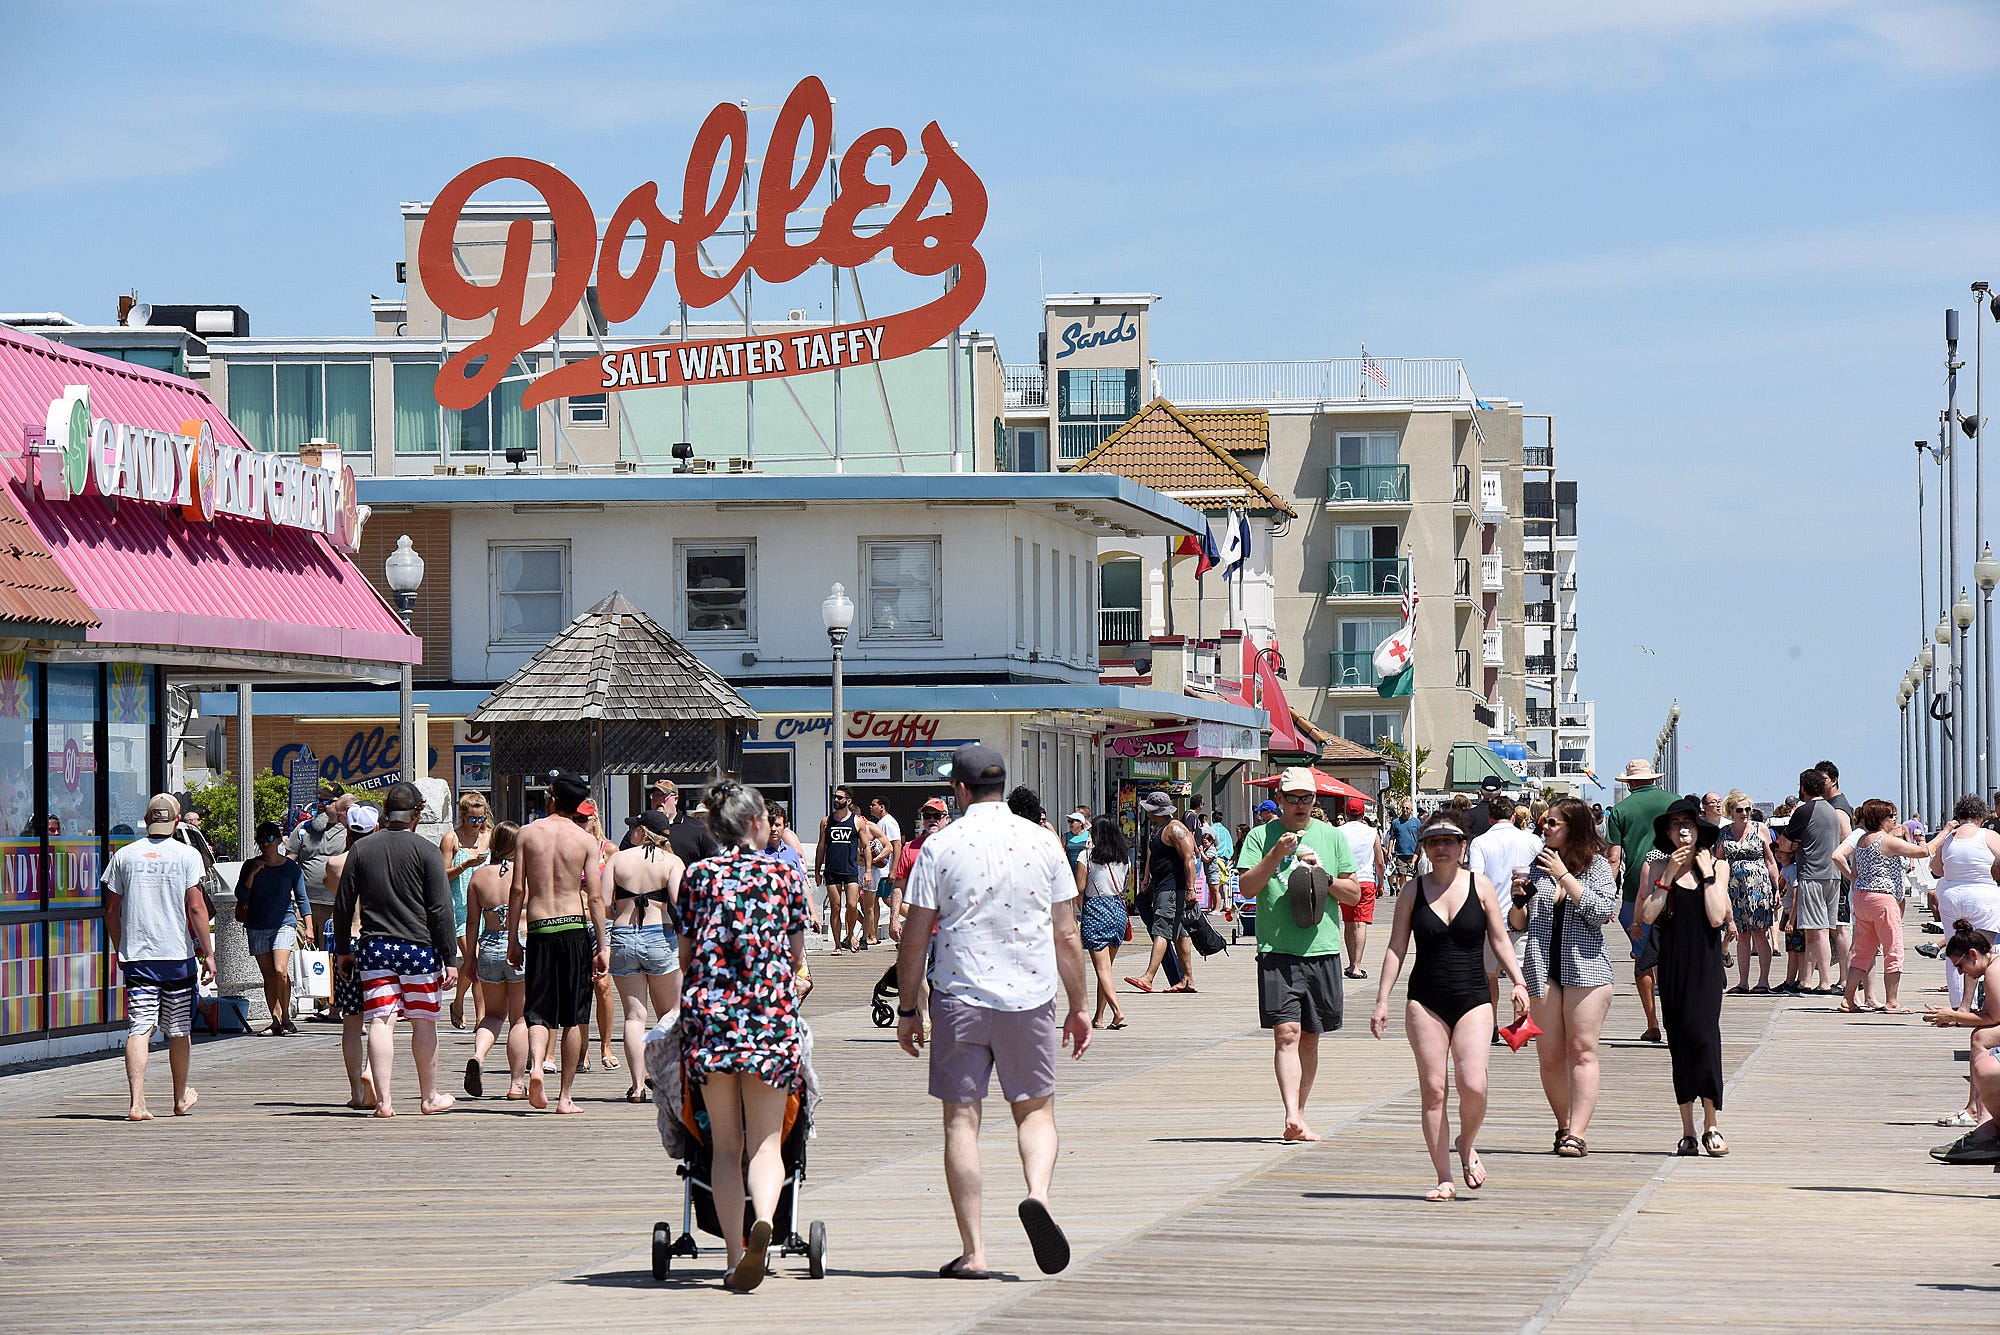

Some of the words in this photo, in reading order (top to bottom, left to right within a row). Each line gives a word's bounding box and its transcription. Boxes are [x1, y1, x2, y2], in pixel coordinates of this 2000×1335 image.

[418, 75, 988, 410] Dolles
[1056, 311, 1136, 359] Sands
[601, 351, 670, 388] SALT
[678, 339, 785, 381] WATER
[791, 326, 885, 370] TAFFY
[92, 418, 196, 505] CANDY
[215, 443, 341, 534] KITCHEN
[847, 711, 940, 748] Taffy
[64, 747, 76, 784] 80
[859, 761, 877, 769] NITRO
[830, 830, 852, 841] GW
[0, 853, 40, 894] NDY
